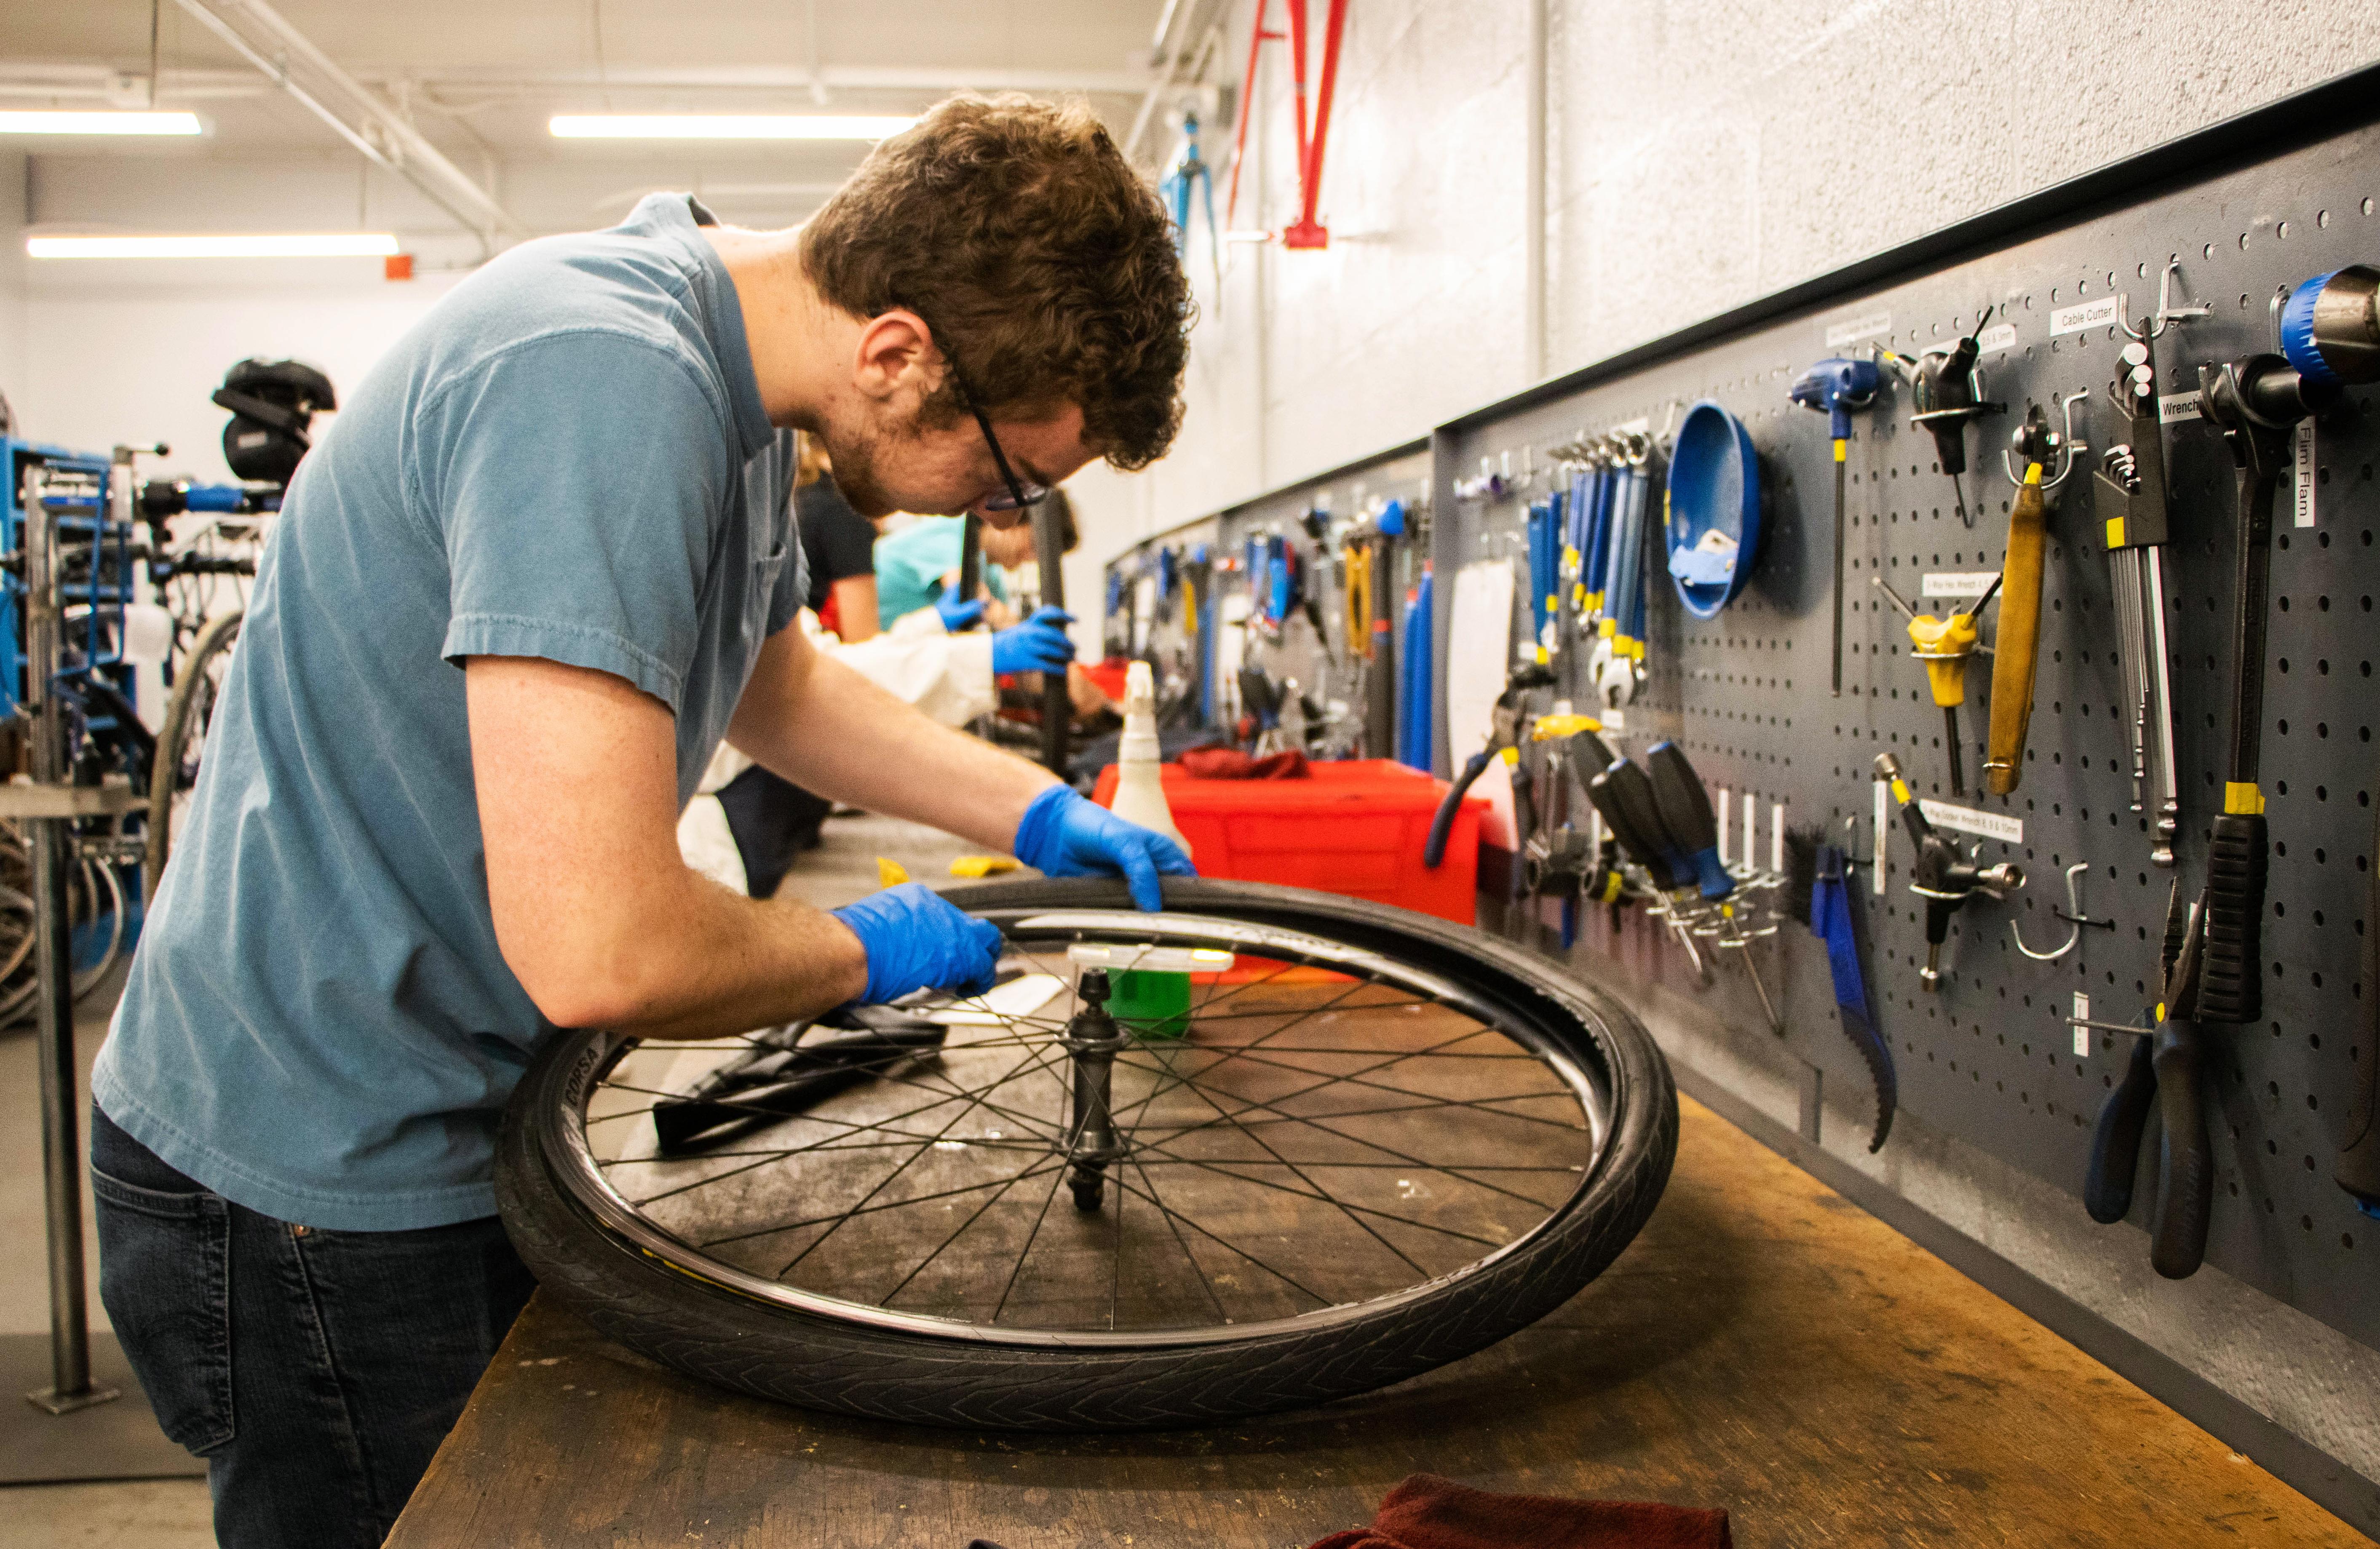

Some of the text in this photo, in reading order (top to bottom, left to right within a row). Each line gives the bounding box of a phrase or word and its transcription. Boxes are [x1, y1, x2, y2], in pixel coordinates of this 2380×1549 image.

[2062, 307, 2112, 326] Cable Cutter
[2163, 398, 2198, 416] Wrench
[2299, 427, 2310, 516] Flim Flam
[565, 1047, 598, 1107] CORSA
